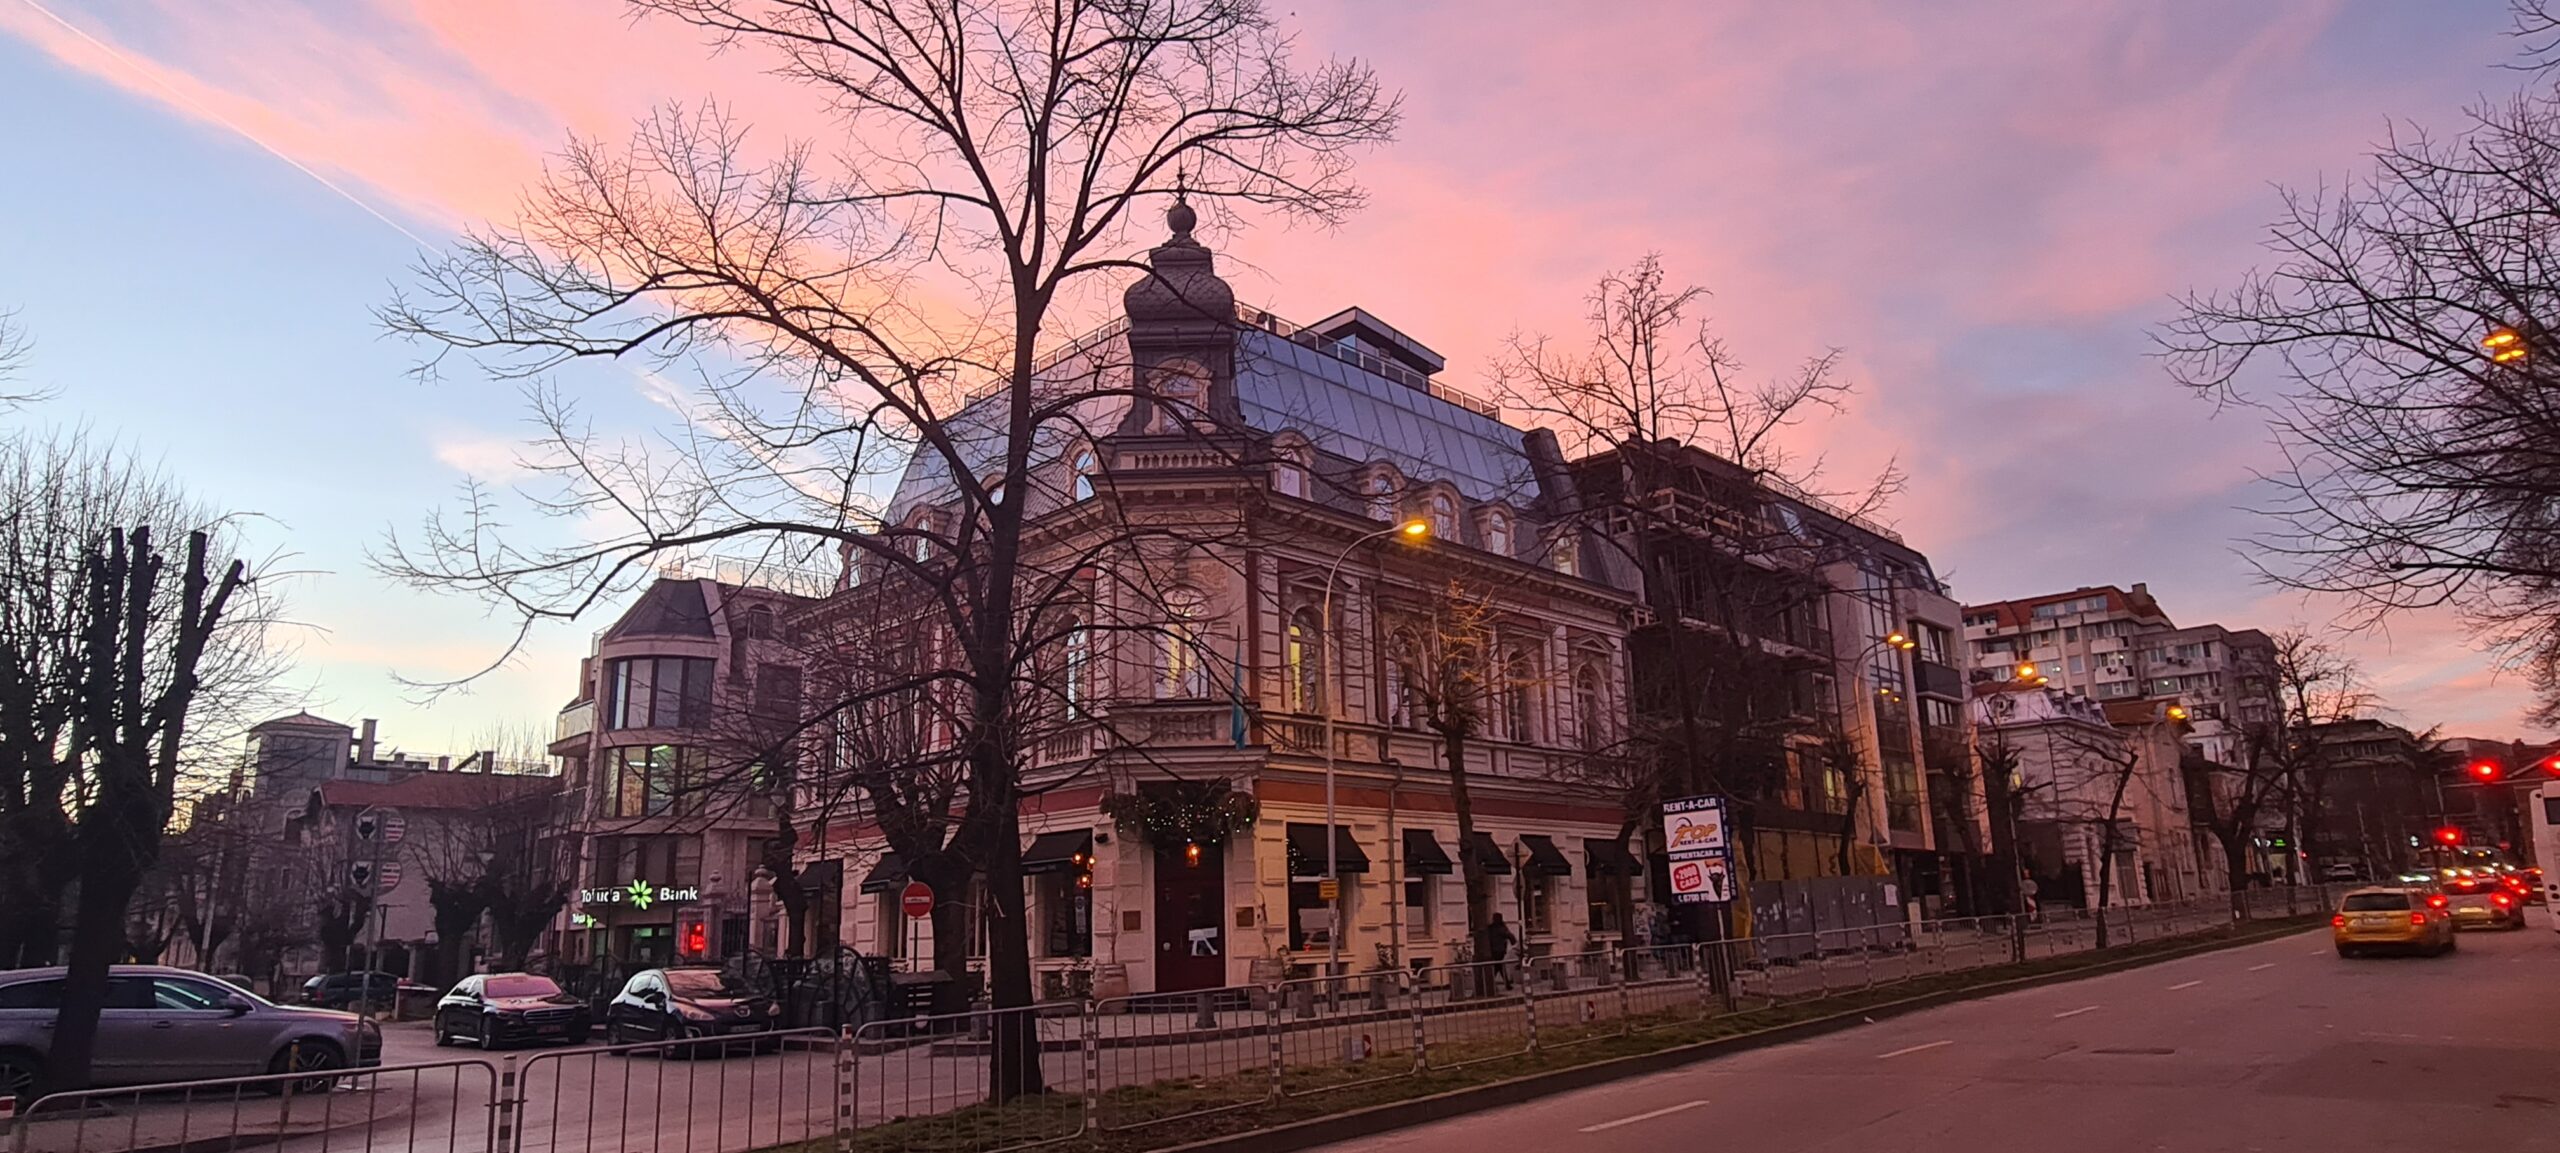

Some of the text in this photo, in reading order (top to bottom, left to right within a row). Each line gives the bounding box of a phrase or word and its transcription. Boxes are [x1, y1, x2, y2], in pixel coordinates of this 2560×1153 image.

[1663, 798, 1717, 813] RENT-A-CAR
[1670, 823, 1718, 848] TOP
[1680, 837, 1718, 846] RENT-A-CAR
[1680, 876, 1700, 889] CARS
[660, 886, 698, 901] Bank
